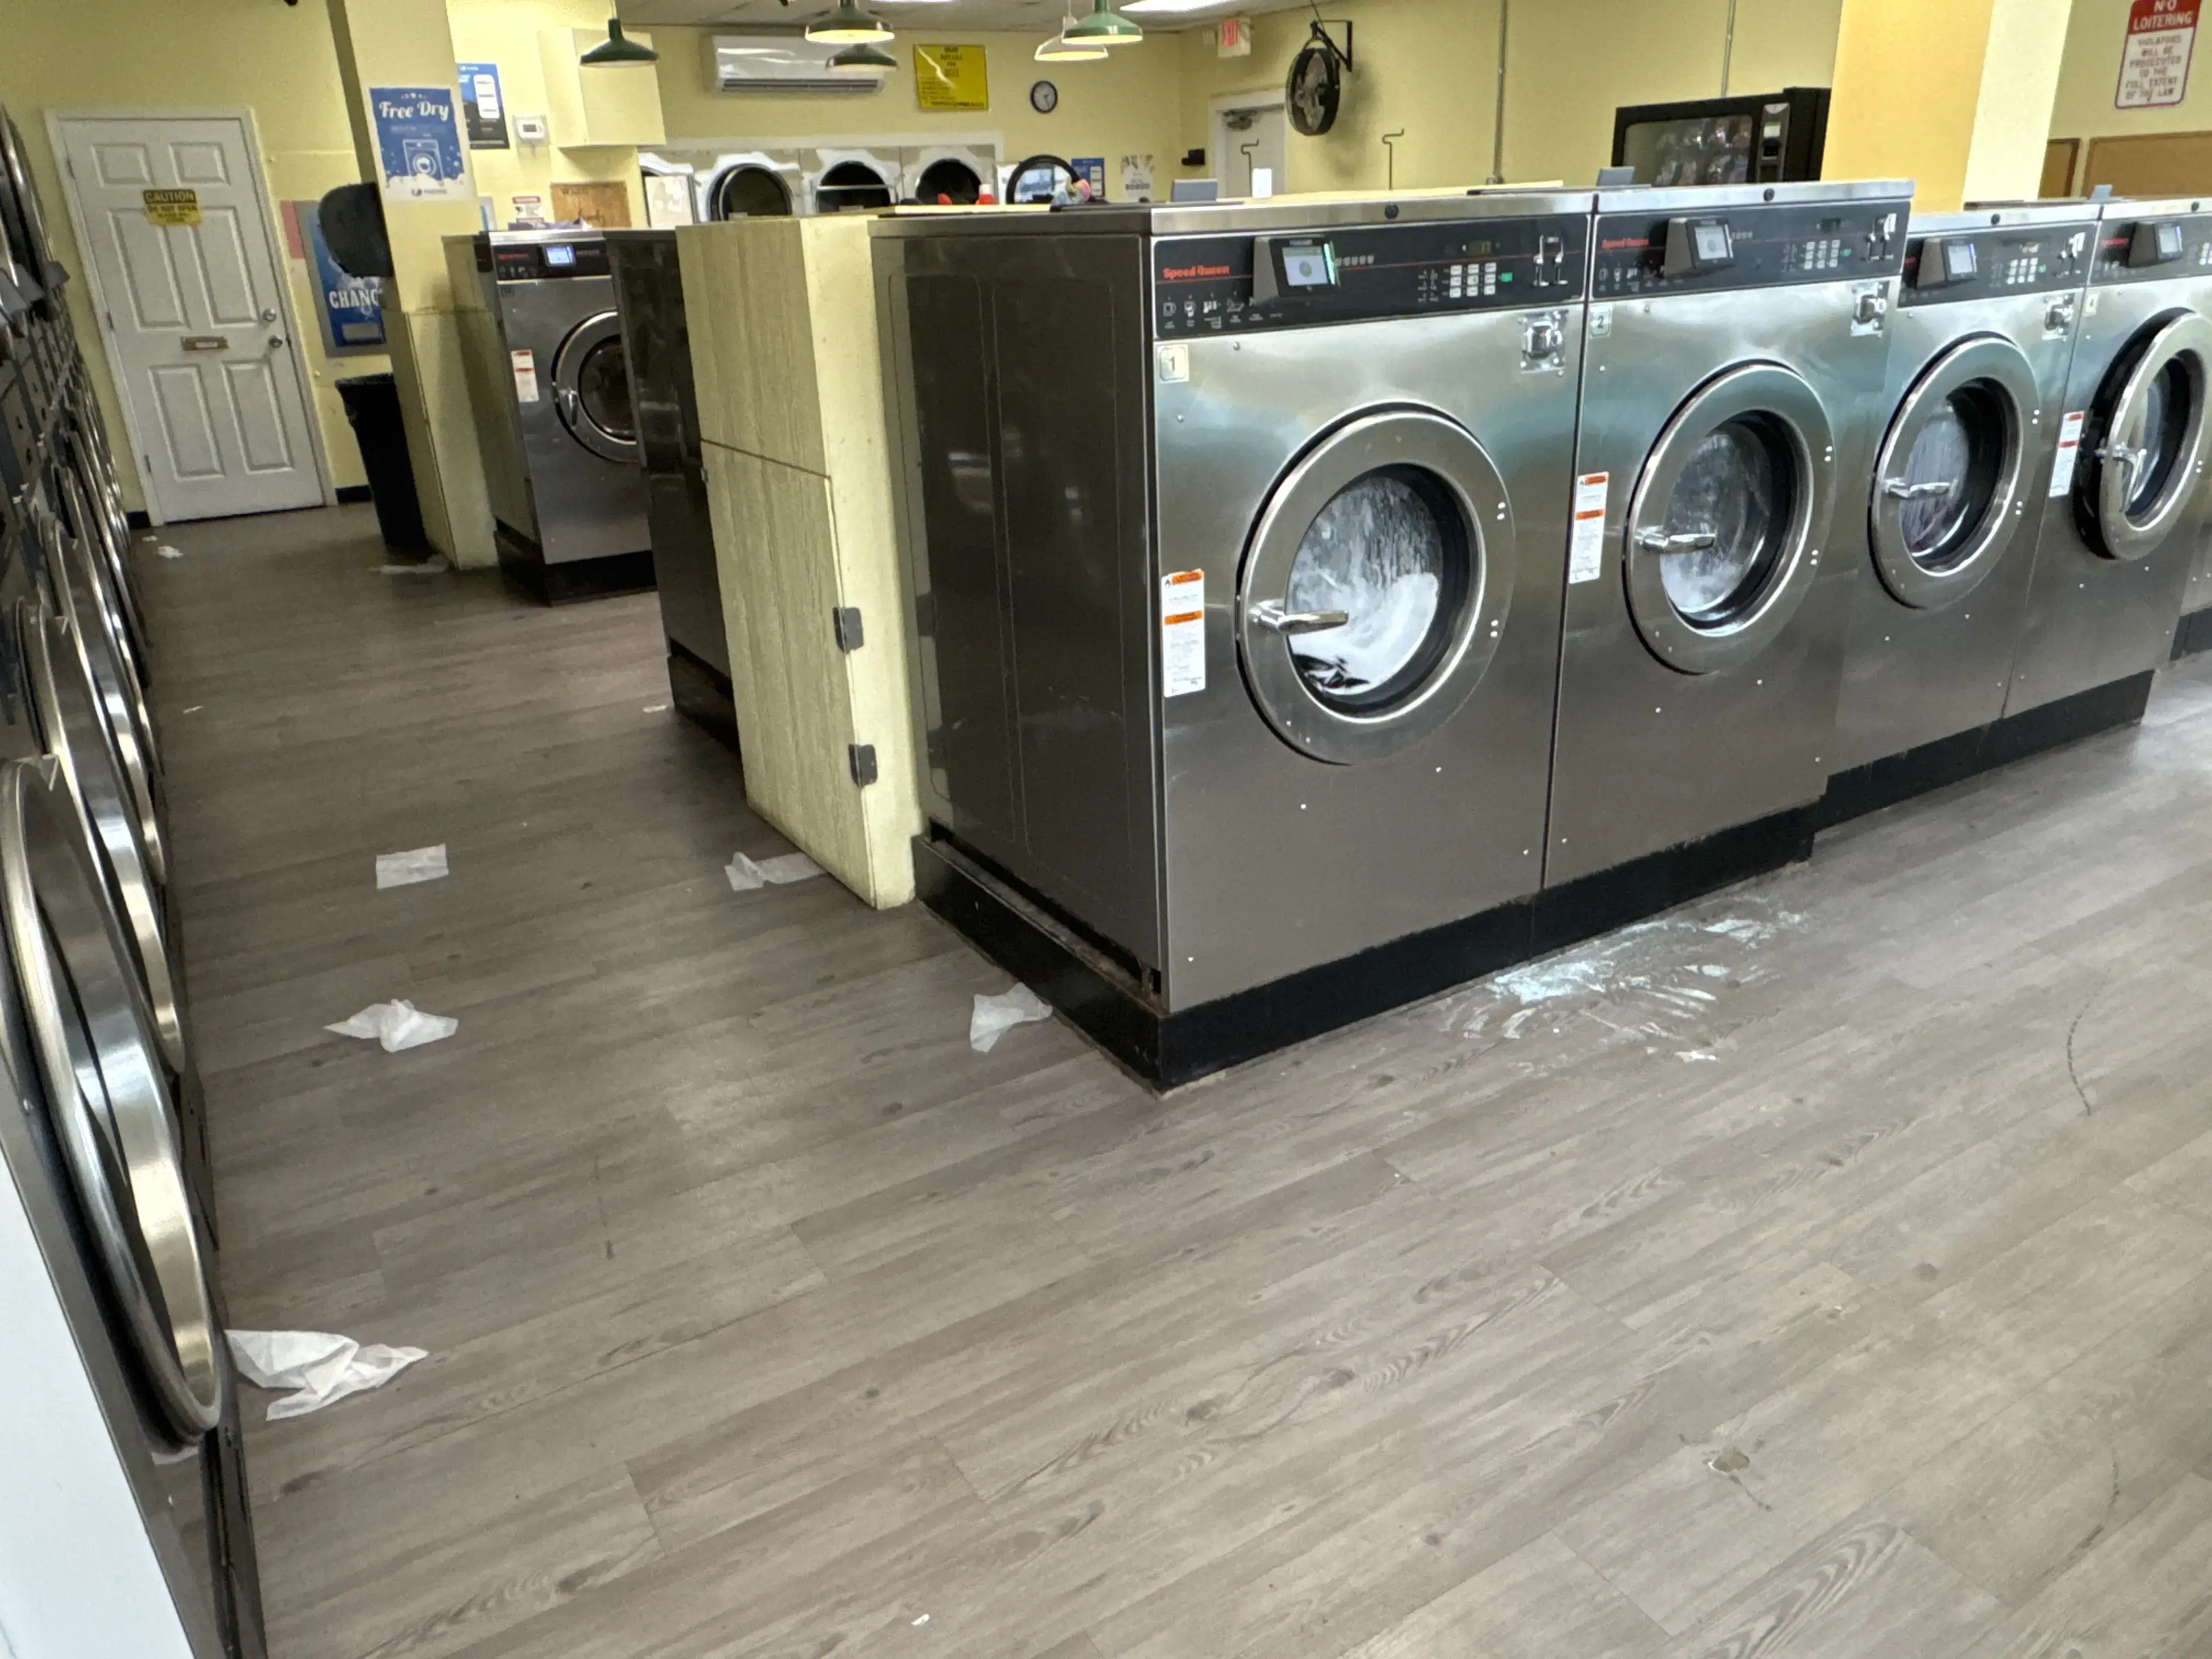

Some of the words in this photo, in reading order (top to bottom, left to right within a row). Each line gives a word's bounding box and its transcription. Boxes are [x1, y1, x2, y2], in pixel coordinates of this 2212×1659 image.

[2153, 0, 2177, 12] NO
[2133, 11, 2193, 31] LOITERING
[379, 101, 414, 119] Free
[416, 100, 449, 122] Dry
[145, 191, 195, 203] CAUTION
[1163, 266, 1196, 280] Speed
[329, 288, 383, 309] CHANG
[1596, 315, 1605, 329] 2
[1169, 356, 1175, 372] 1
